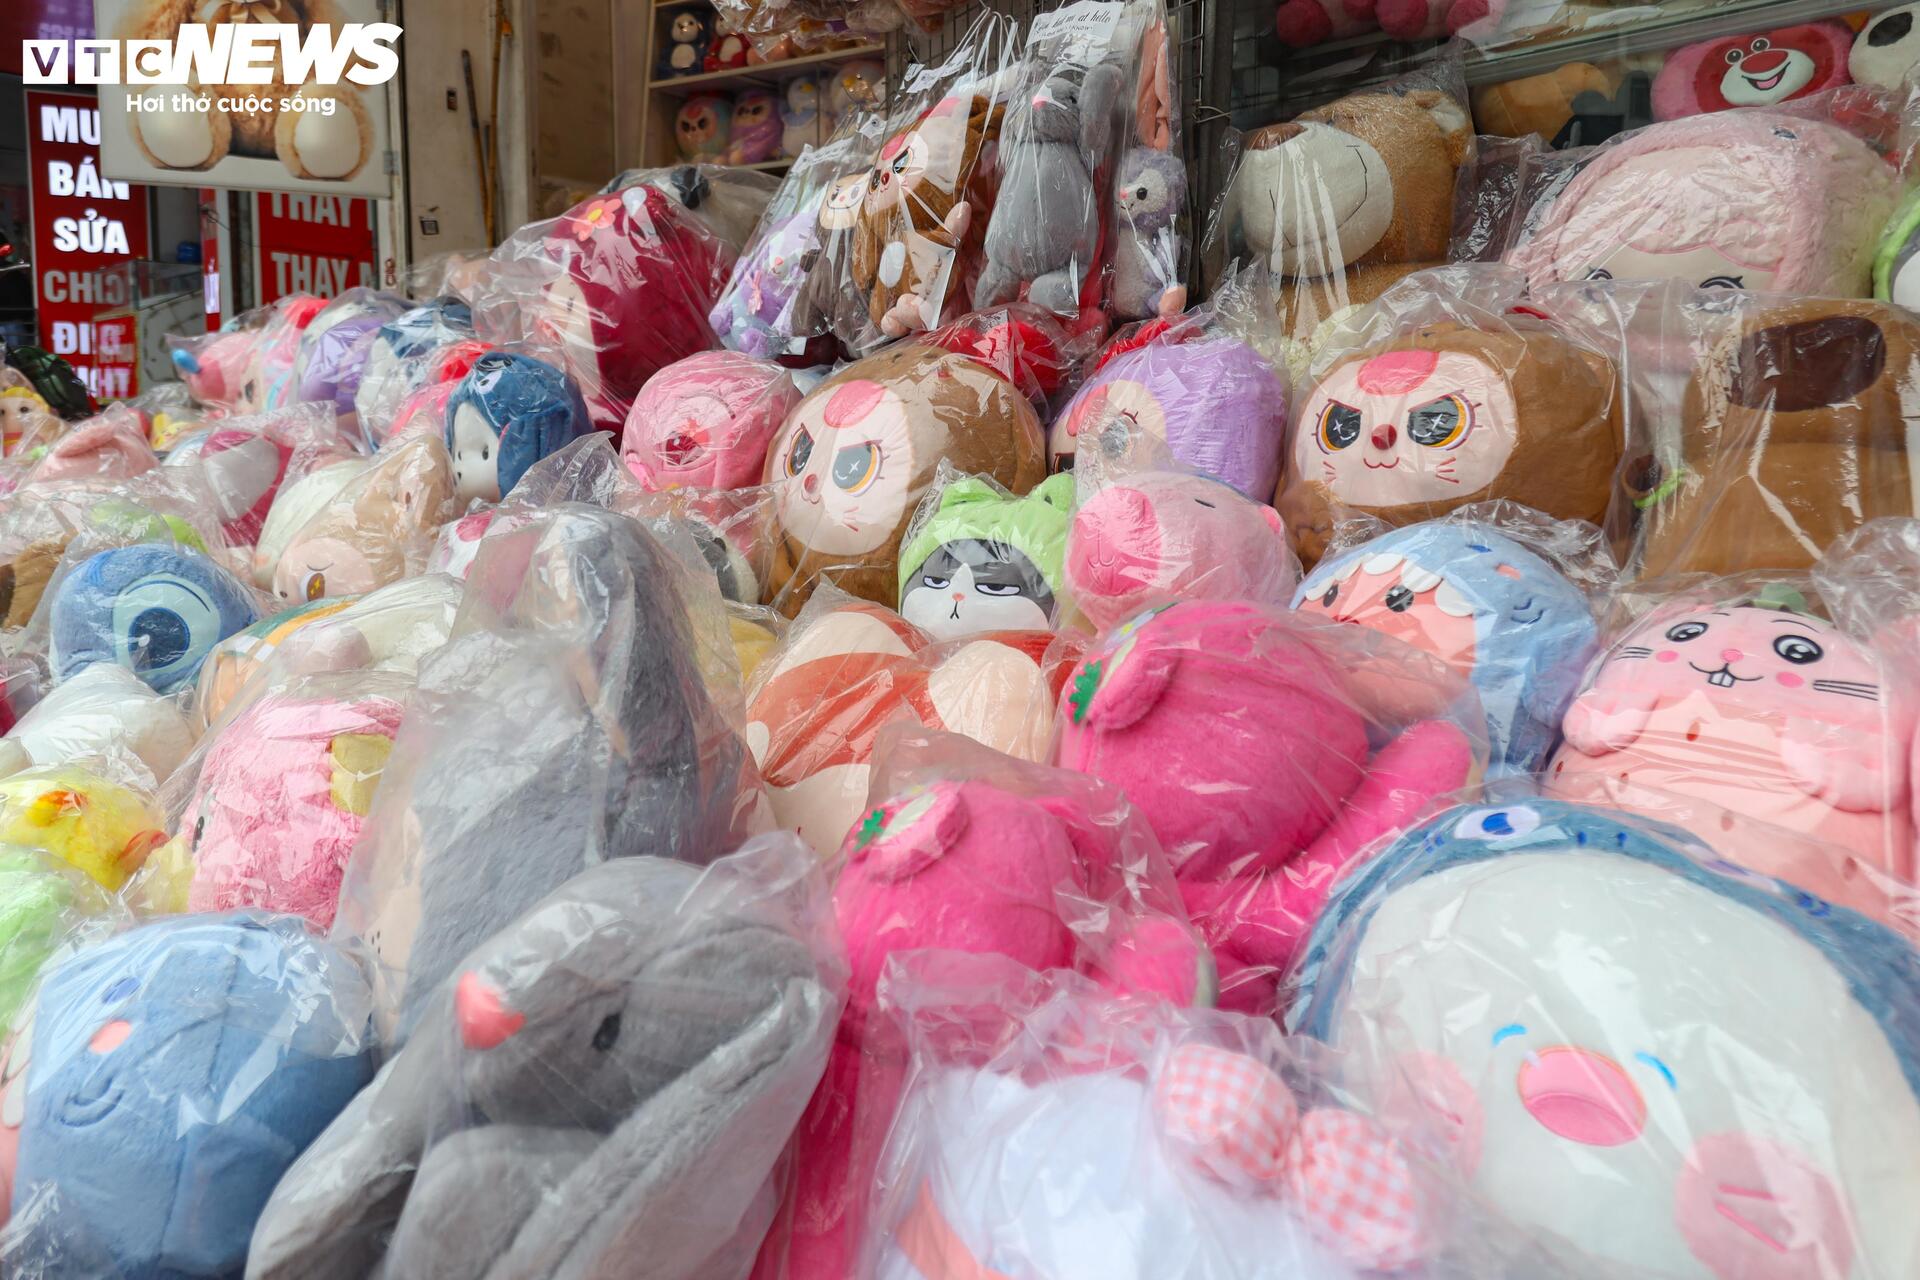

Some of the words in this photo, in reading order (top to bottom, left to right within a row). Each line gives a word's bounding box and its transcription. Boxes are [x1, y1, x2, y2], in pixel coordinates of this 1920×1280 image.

[41, 105, 100, 145] MU
[53, 208, 130, 254] SỬA
[271, 252, 349, 299] THAY
